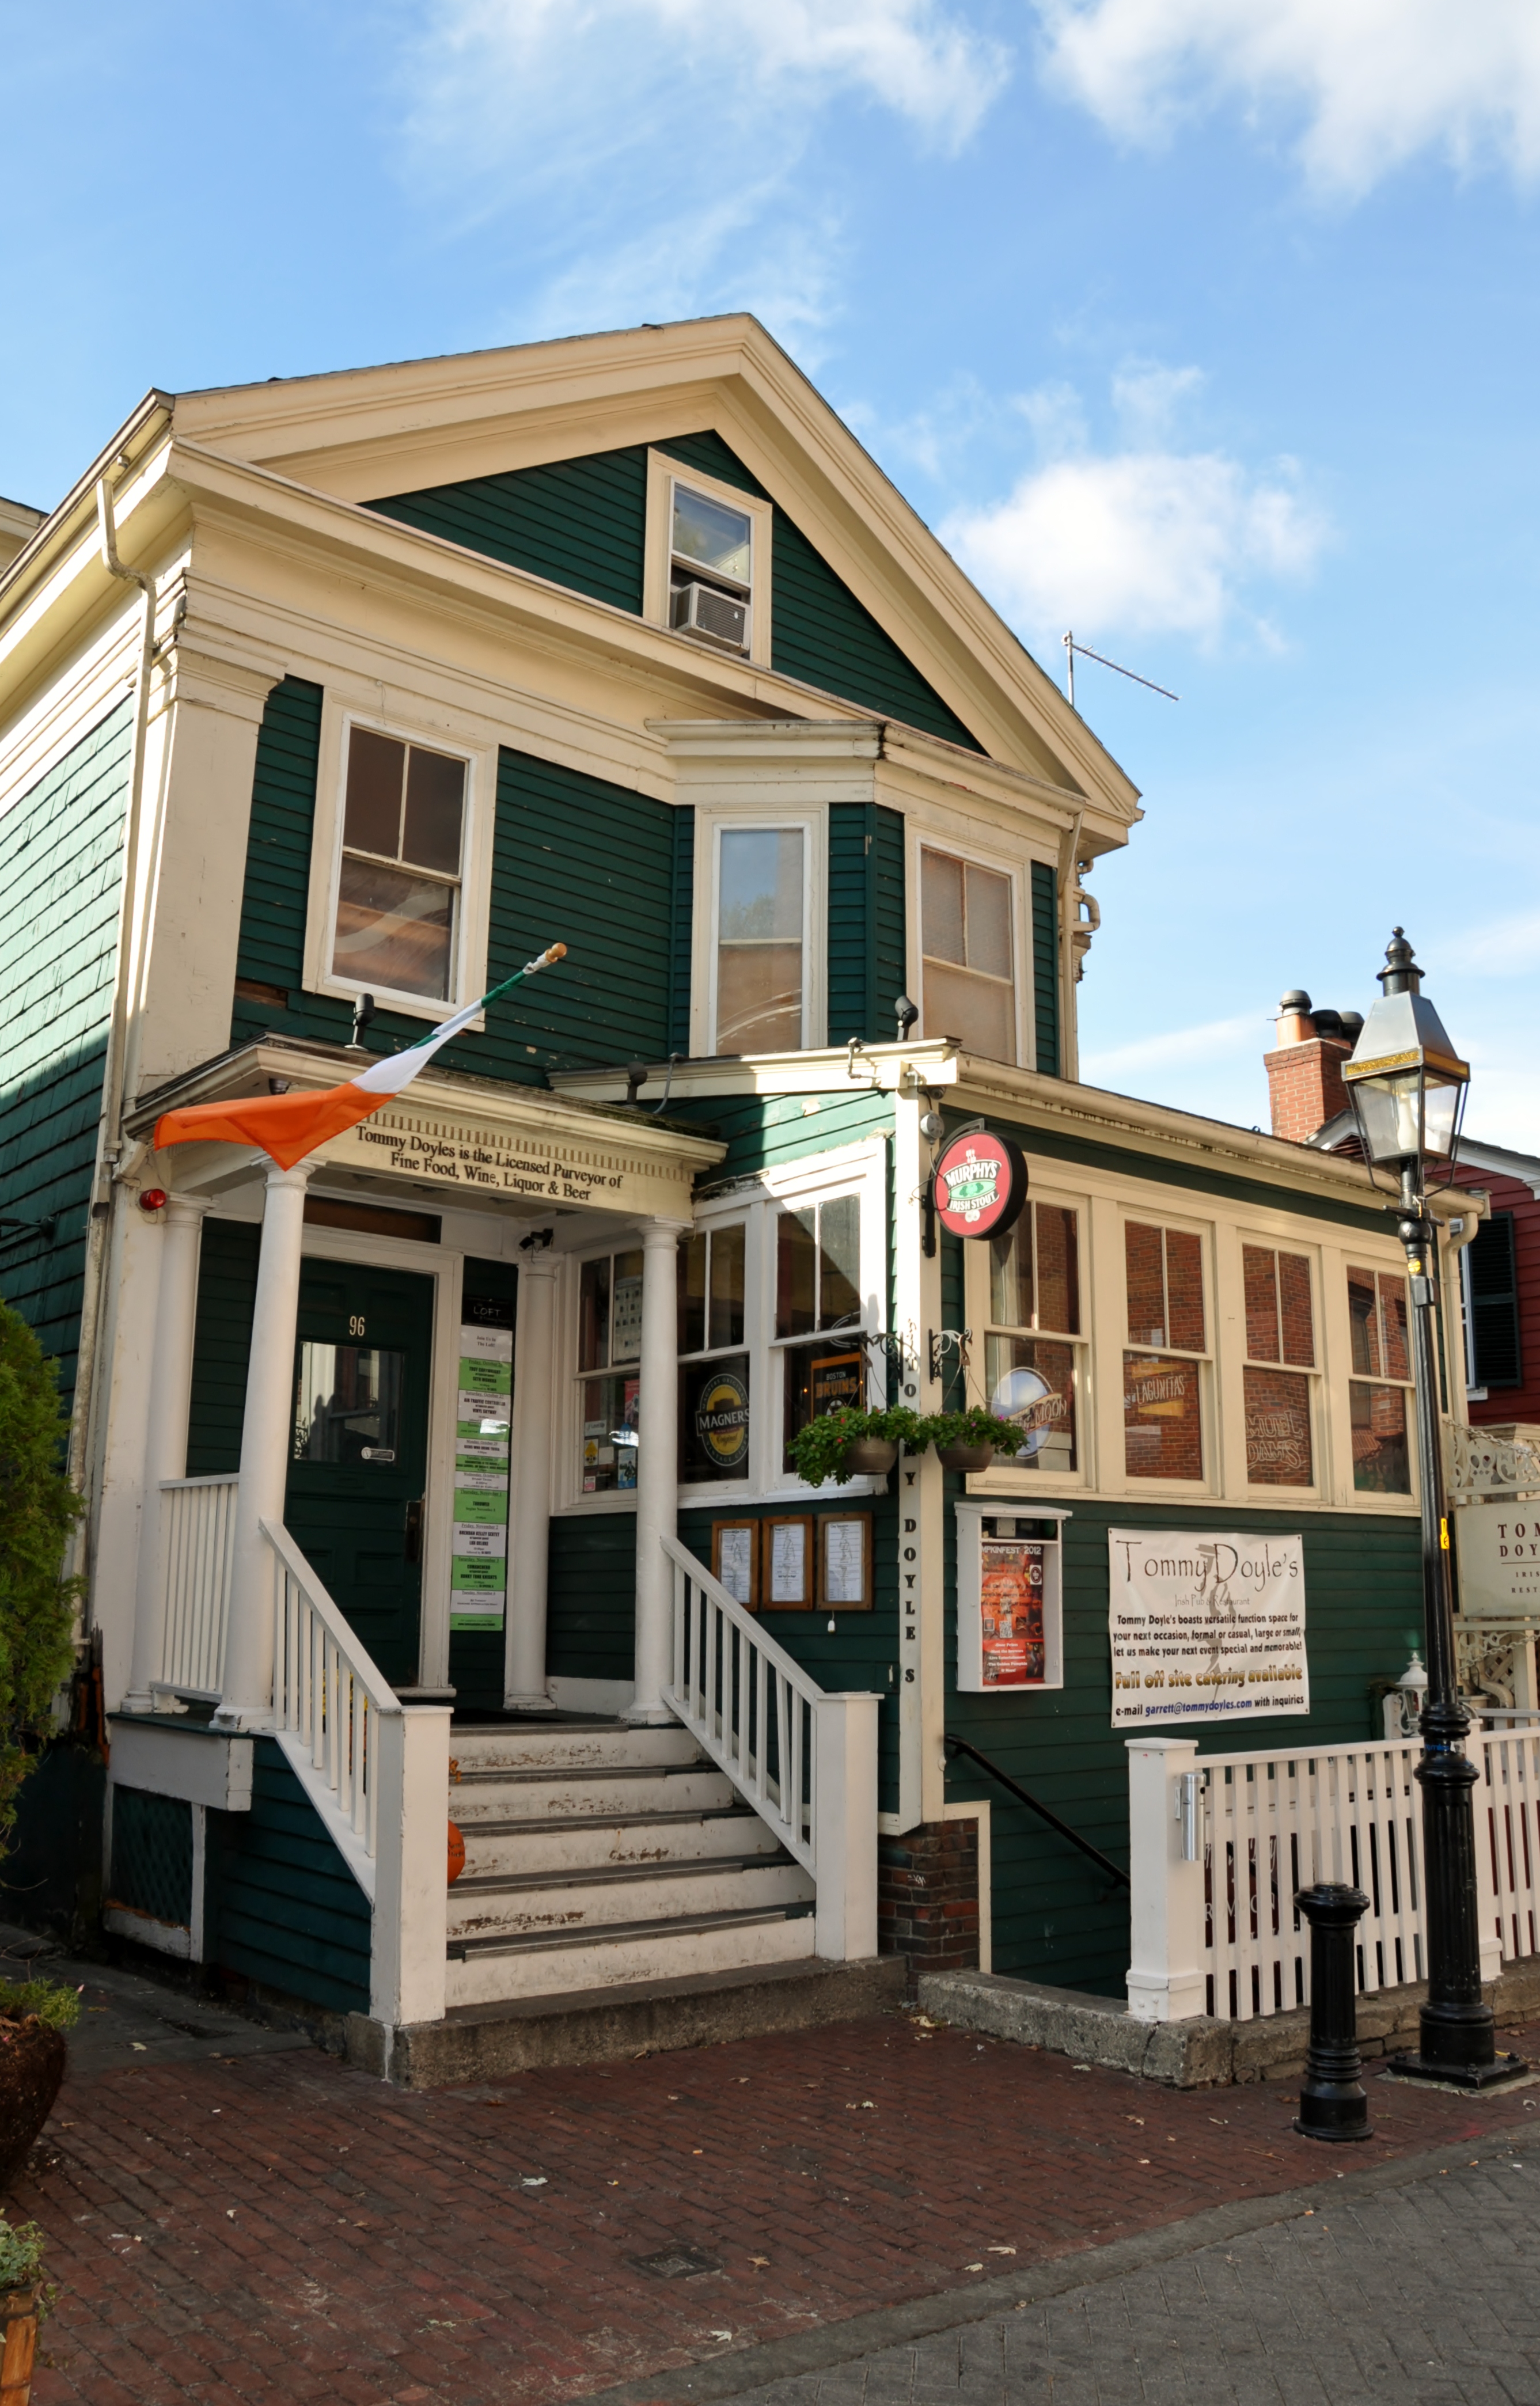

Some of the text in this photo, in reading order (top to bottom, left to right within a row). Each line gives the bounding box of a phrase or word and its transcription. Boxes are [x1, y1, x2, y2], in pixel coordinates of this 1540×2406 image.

[356, 1125, 623, 1189] Tommy Doyles is the Licensed Purveyor of
[391, 1152, 591, 1200] Fine Food, Wine, Liquor & Beer
[950, 1191, 996, 1211] IRISH STOUT
[473, 1306, 502, 1316] LOFT
[350, 1316, 365, 1336] 96
[826, 1371, 846, 1380] BOSTON
[816, 1376, 857, 1399] BRUINS
[1136, 1375, 1185, 1404] LAGUNITAS
[699, 1409, 749, 1430] MAGNERS
[1035, 1400, 1067, 1426] MOON
[1024, 1546, 1041, 1555] 2012
[1500, 1544, 1538, 1557] DOY
[1116, 1540, 1298, 1592] Tommy Doyle's
[904, 1519, 917, 1683] DOYLES
[1175, 1594, 1189, 1607] Irish
[1191, 1594, 1204, 1607] Pub
[1213, 1595, 1250, 1607] Restaurant
[1117, 1612, 1298, 1627] Tommy Doyle's boasts versatile function space for
[1113, 1632, 1131, 1642] your
[1133, 1631, 1151, 1640] next
[1154, 1630, 1189, 1642] occasion,
[1192, 1630, 1216, 1640] formal
[1218, 1631, 1226, 1639] or
[1228, 1629, 1253, 1640] casual,
[1255, 1628, 1273, 1640] large
[1283, 1627, 1301, 1638] small,
[1114, 1641, 1302, 1658] let us make your next event special and memorable!
[1116, 1664, 1303, 1690] Full off site catering available
[1116, 1694, 1304, 1717] e-mail garrett@tommydoyles.com with inquiries
